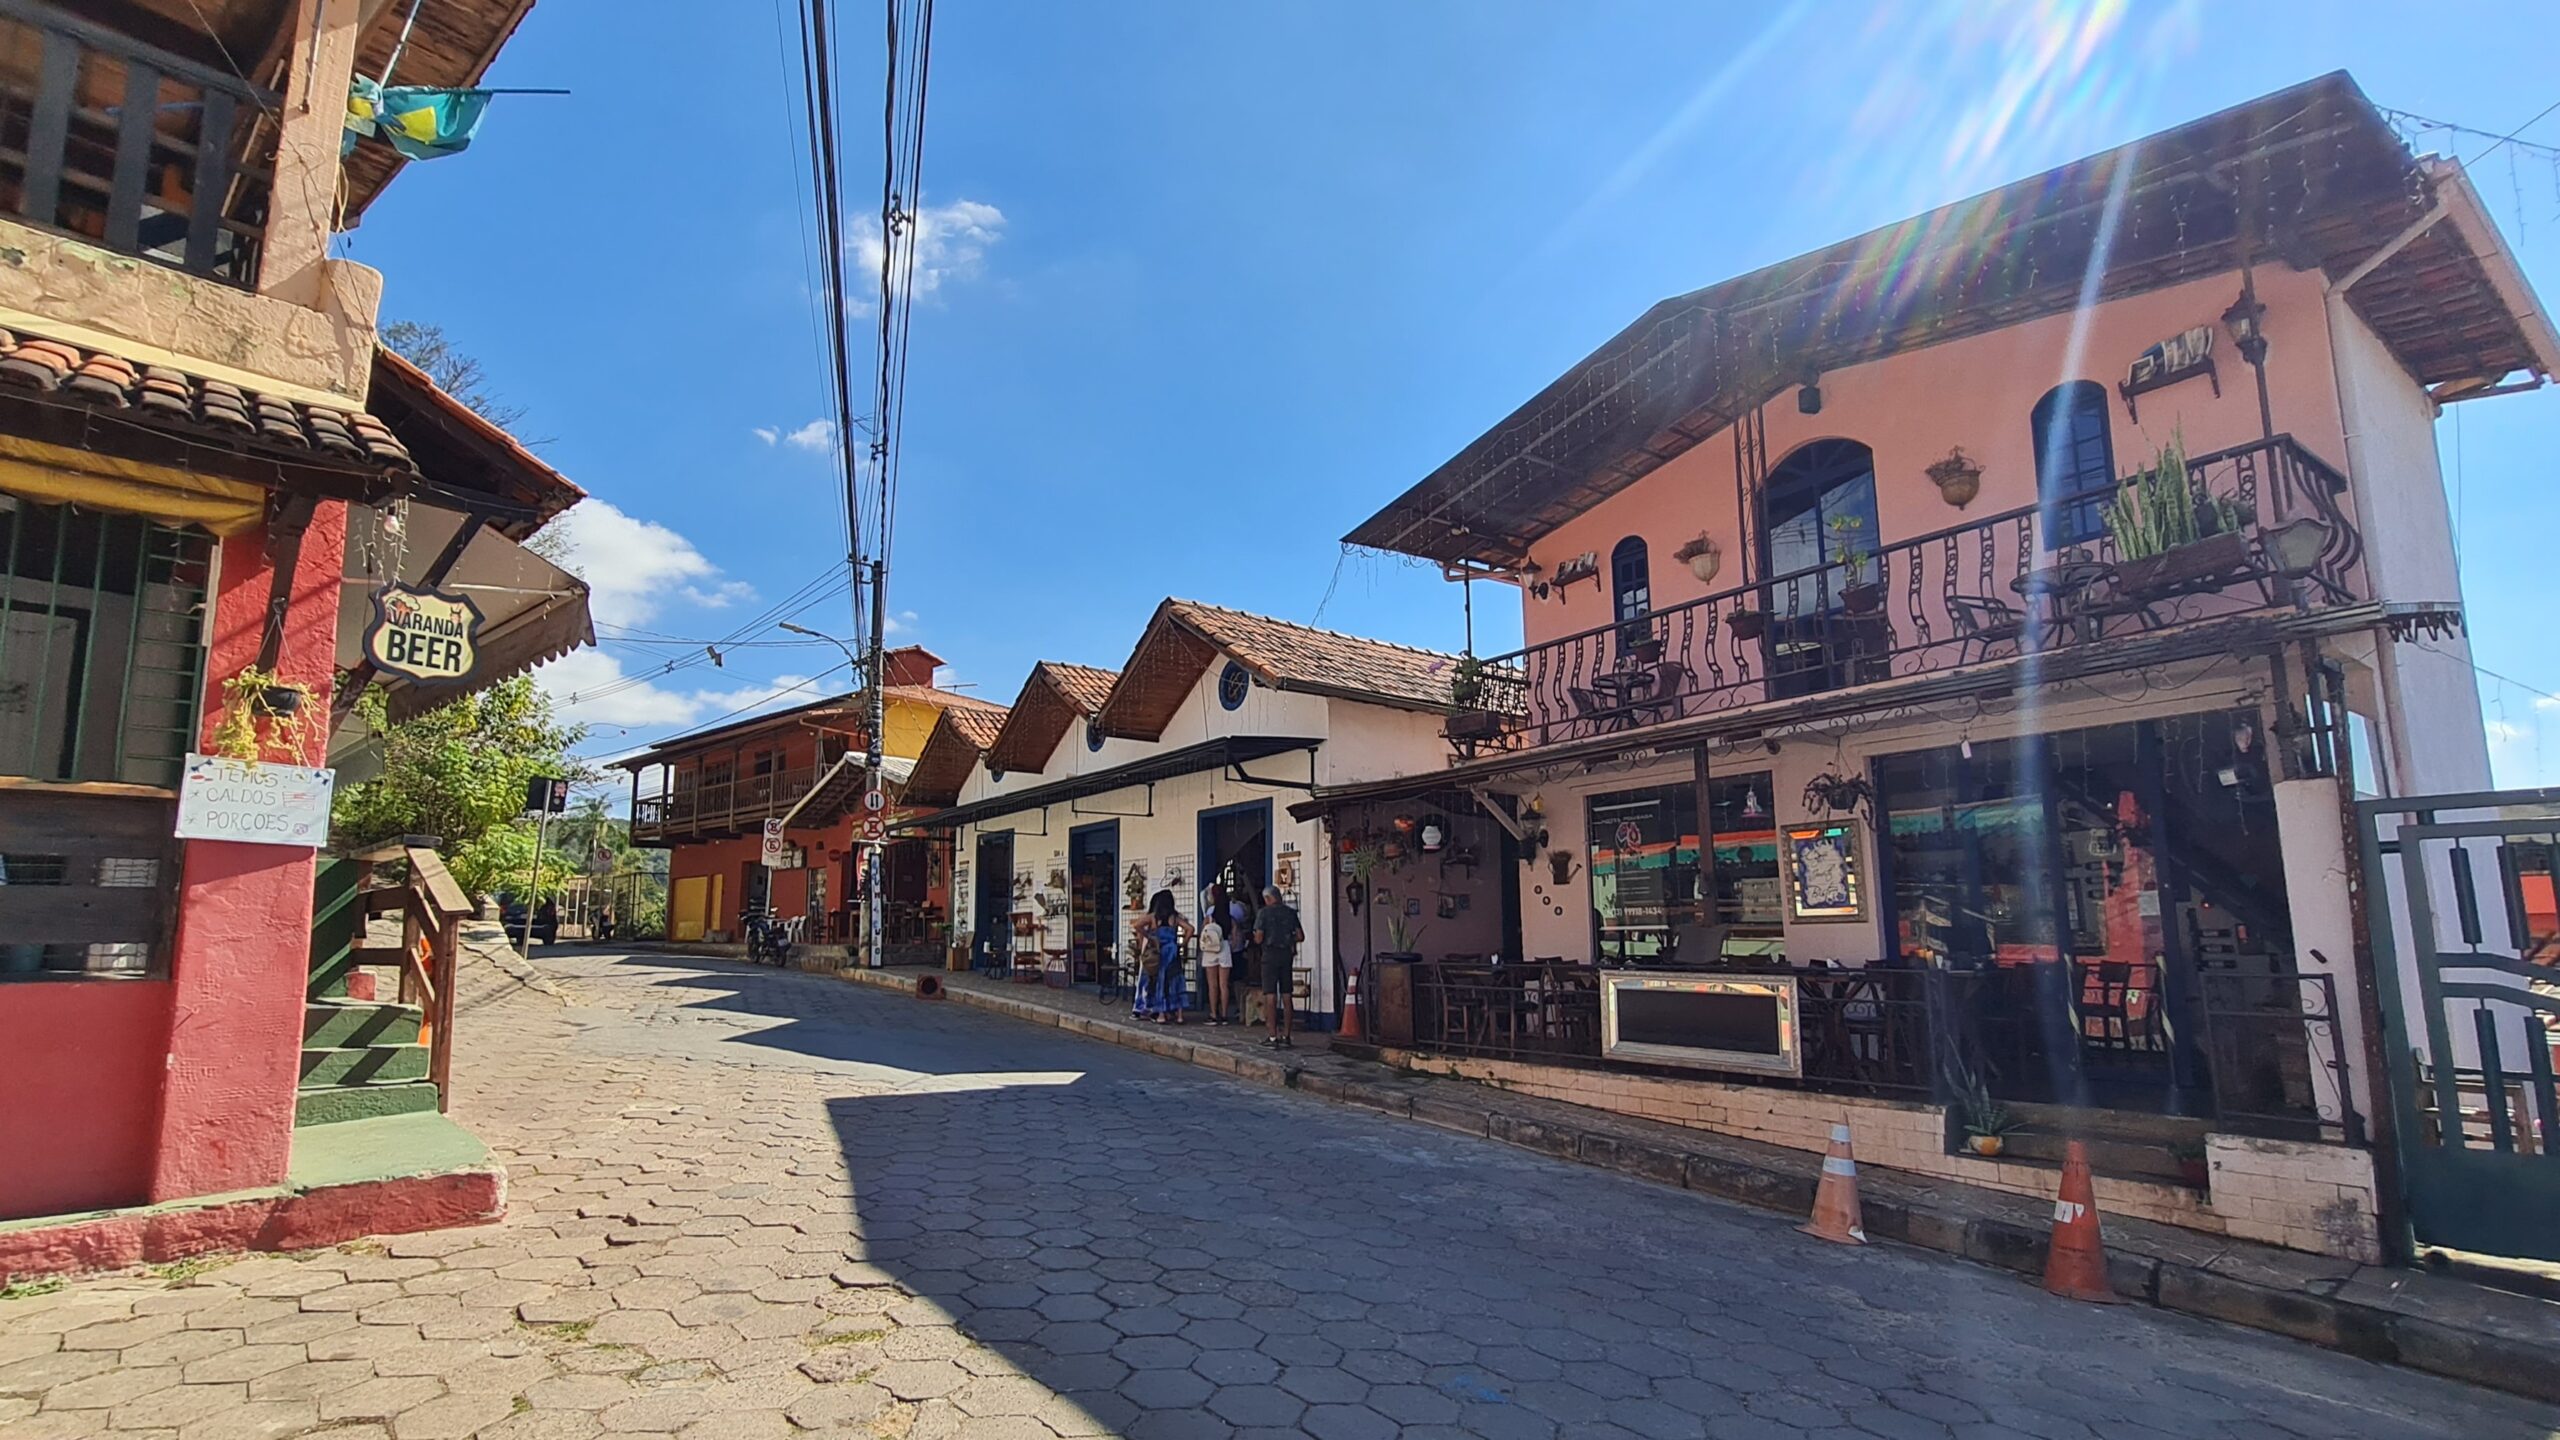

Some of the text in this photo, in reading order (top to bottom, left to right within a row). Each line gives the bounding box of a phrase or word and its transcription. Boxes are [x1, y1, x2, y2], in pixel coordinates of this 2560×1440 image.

[390, 608, 464, 639] VARANDA
[386, 628, 462, 673] BEER
[206, 787, 277, 806] CALDOS
